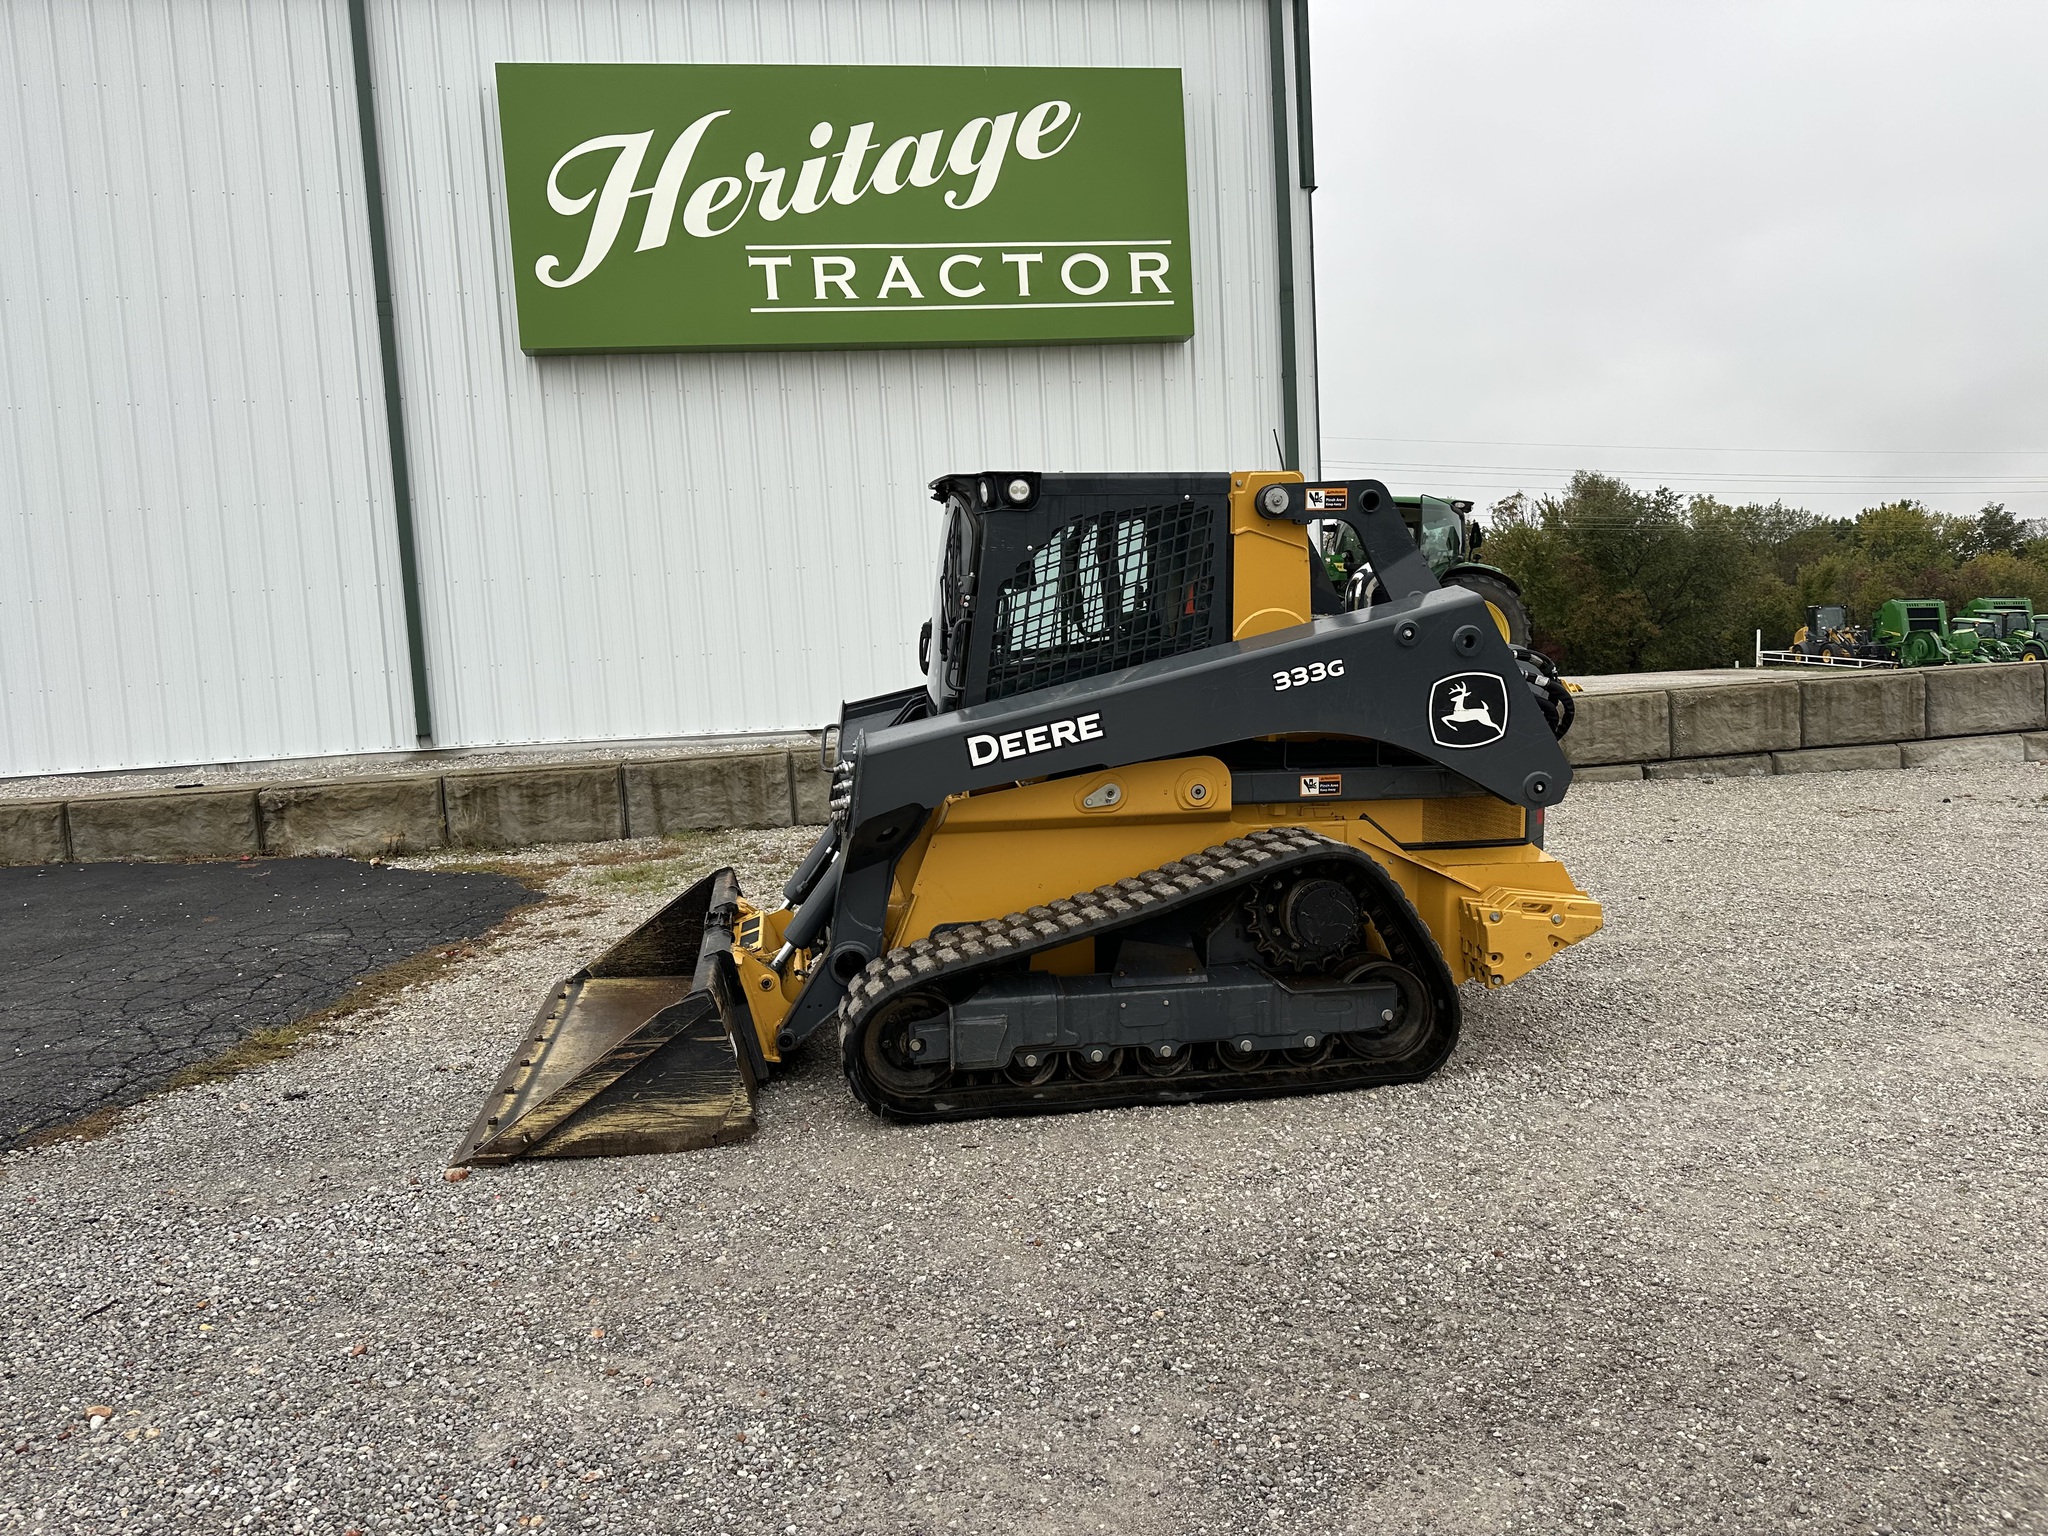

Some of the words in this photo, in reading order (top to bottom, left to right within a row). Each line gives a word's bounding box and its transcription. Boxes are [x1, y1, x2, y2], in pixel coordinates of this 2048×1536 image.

[536, 100, 1082, 289] Heritage
[747, 251, 1172, 300] TRACTOR
[1272, 659, 1345, 691] 333G
[966, 712, 1104, 767] DEERE
